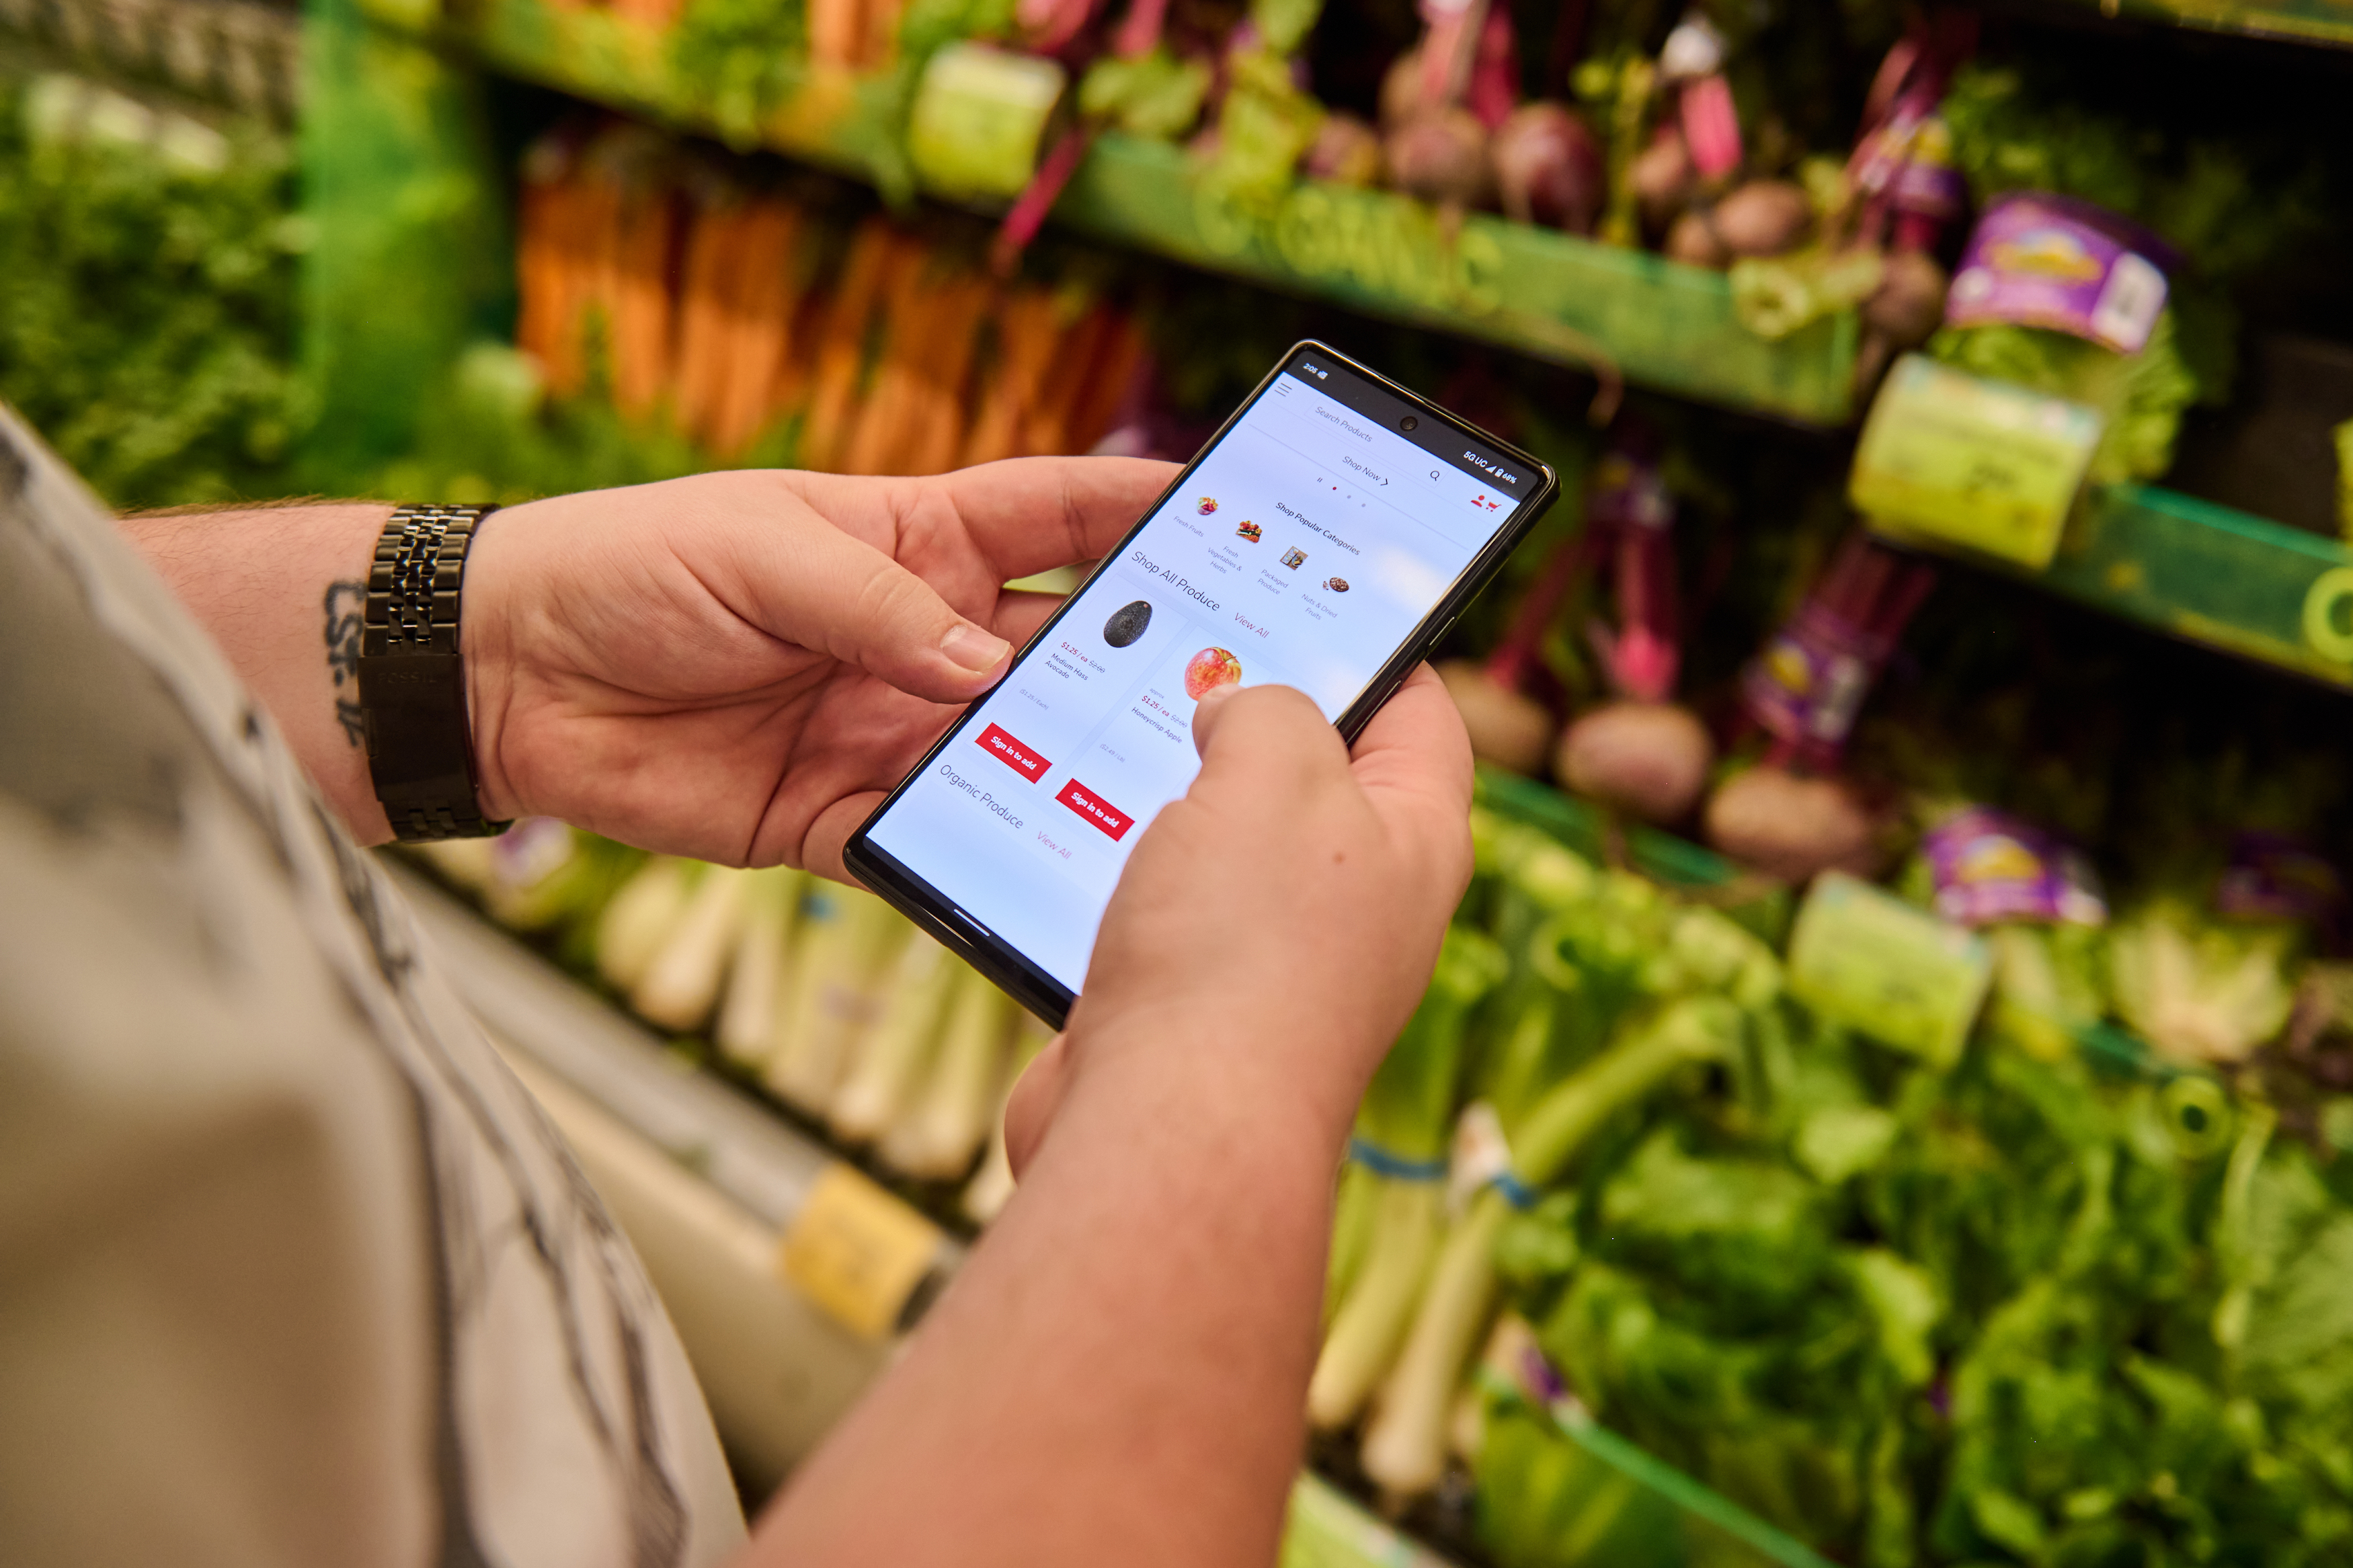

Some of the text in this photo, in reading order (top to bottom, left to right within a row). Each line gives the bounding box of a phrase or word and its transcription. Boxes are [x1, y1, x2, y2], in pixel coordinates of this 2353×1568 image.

[1303, 362, 1318, 374] 2:05
[1316, 407, 1372, 442] Search Products
[1343, 456, 1380, 481] Shop Now
[1464, 450, 1488, 468] 5G UC
[1502, 473, 1517, 484] 68%
[1174, 515, 1204, 537] Fresh Fruits
[1276, 501, 1360, 556] Shop Popular Categories
[1207, 547, 1237, 569] Vegetables
[1223, 546, 1238, 559] Fresh
[1209, 560, 1227, 574] Herbs
[1131, 550, 1220, 612] Shop All Produce
[1257, 578, 1281, 595] Produce
[1261, 569, 1289, 589] Packaged
[1302, 594, 1315, 606] Nuts
[1321, 604, 1338, 618] Dried
[1305, 607, 1322, 620] Fruits
[1234, 612, 1269, 638] View All
[1061, 641, 1078, 656] $1.25
[1045, 660, 1070, 679] Avocado
[1051, 653, 1088, 681] Medium Hass
[1142, 695, 1159, 710] $1.25
[1150, 687, 1164, 700] approx
[1131, 706, 1183, 744] Honeycrisp Apple
[991, 735, 1037, 770] Sign in to add
[940, 764, 1023, 829] Organic Produce
[1070, 791, 1119, 828] Sign in to add
[1037, 830, 1072, 860] View All
